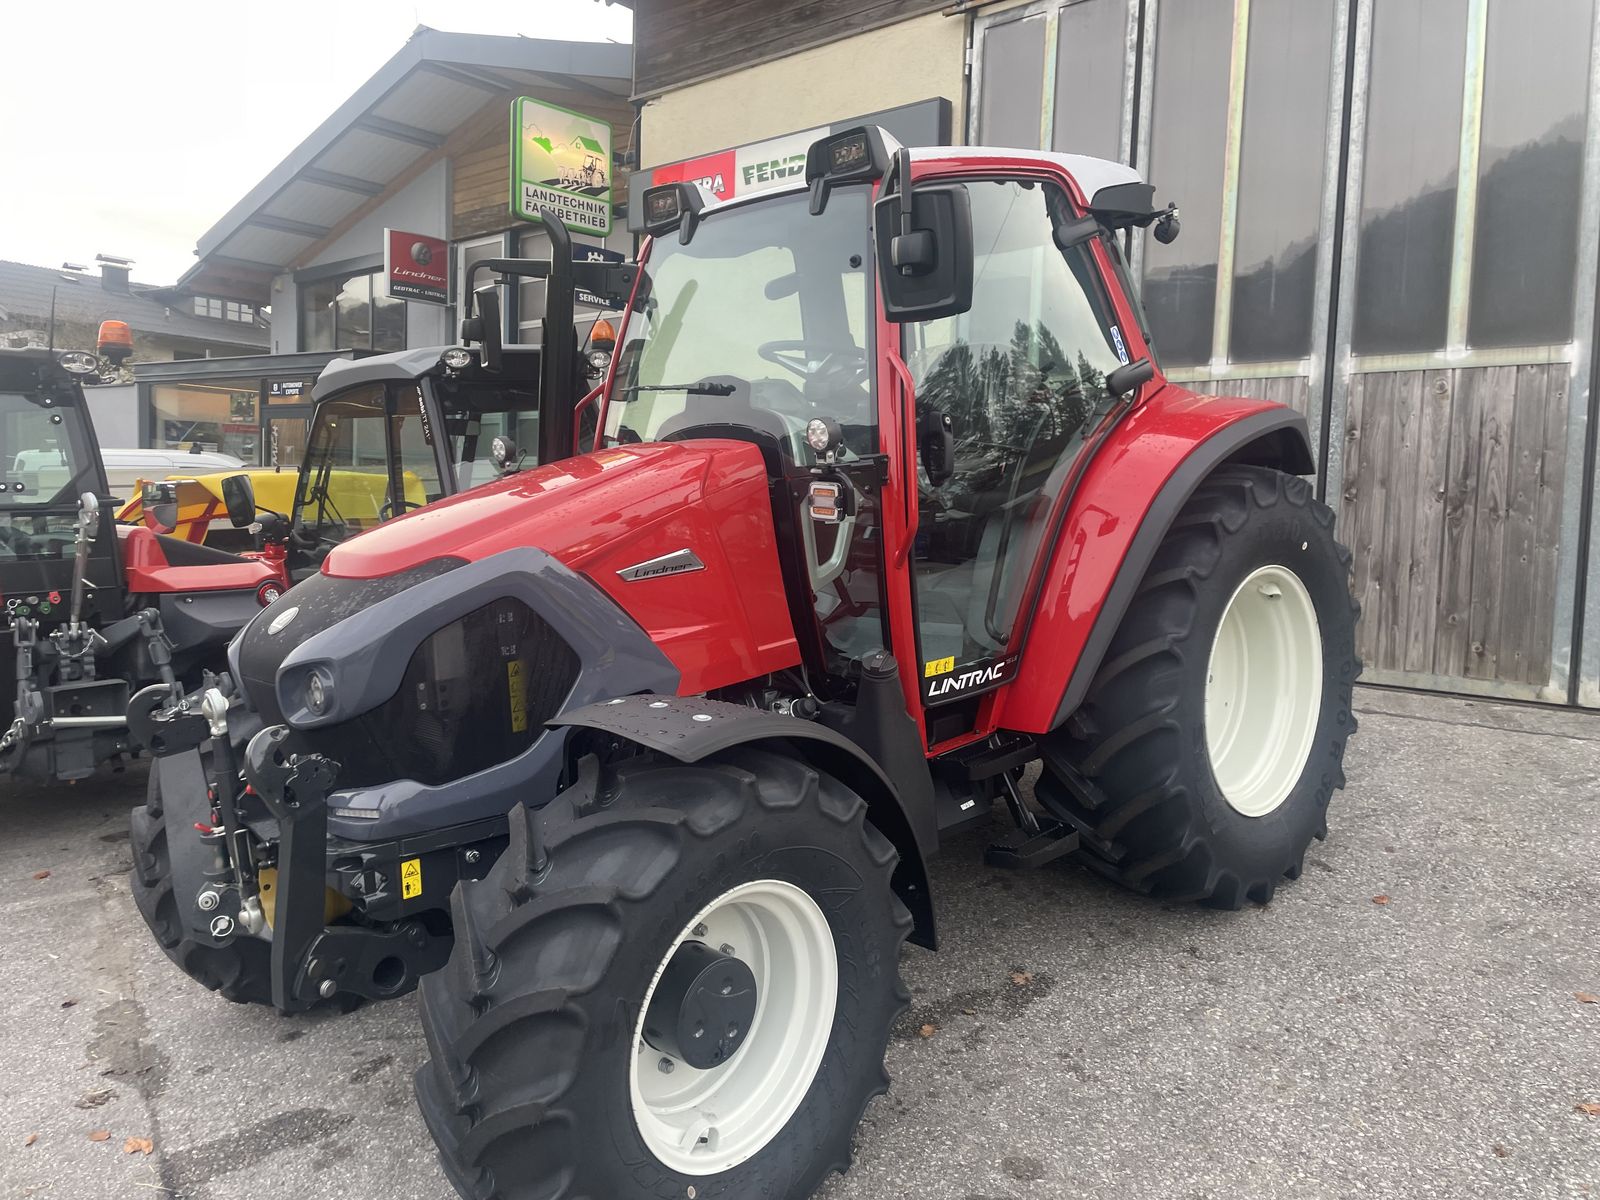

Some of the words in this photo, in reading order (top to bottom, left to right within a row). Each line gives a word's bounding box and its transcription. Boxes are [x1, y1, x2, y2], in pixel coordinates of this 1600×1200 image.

[742, 154, 806, 186] FEND
[525, 186, 606, 215] LANDTECHNIK
[393, 266, 446, 281] Lindner
[393, 285, 421, 293] GEOTRAC
[578, 292, 611, 306] SERVICE
[634, 563, 692, 578] Lindner
[928, 662, 1005, 697] LINTRAC
